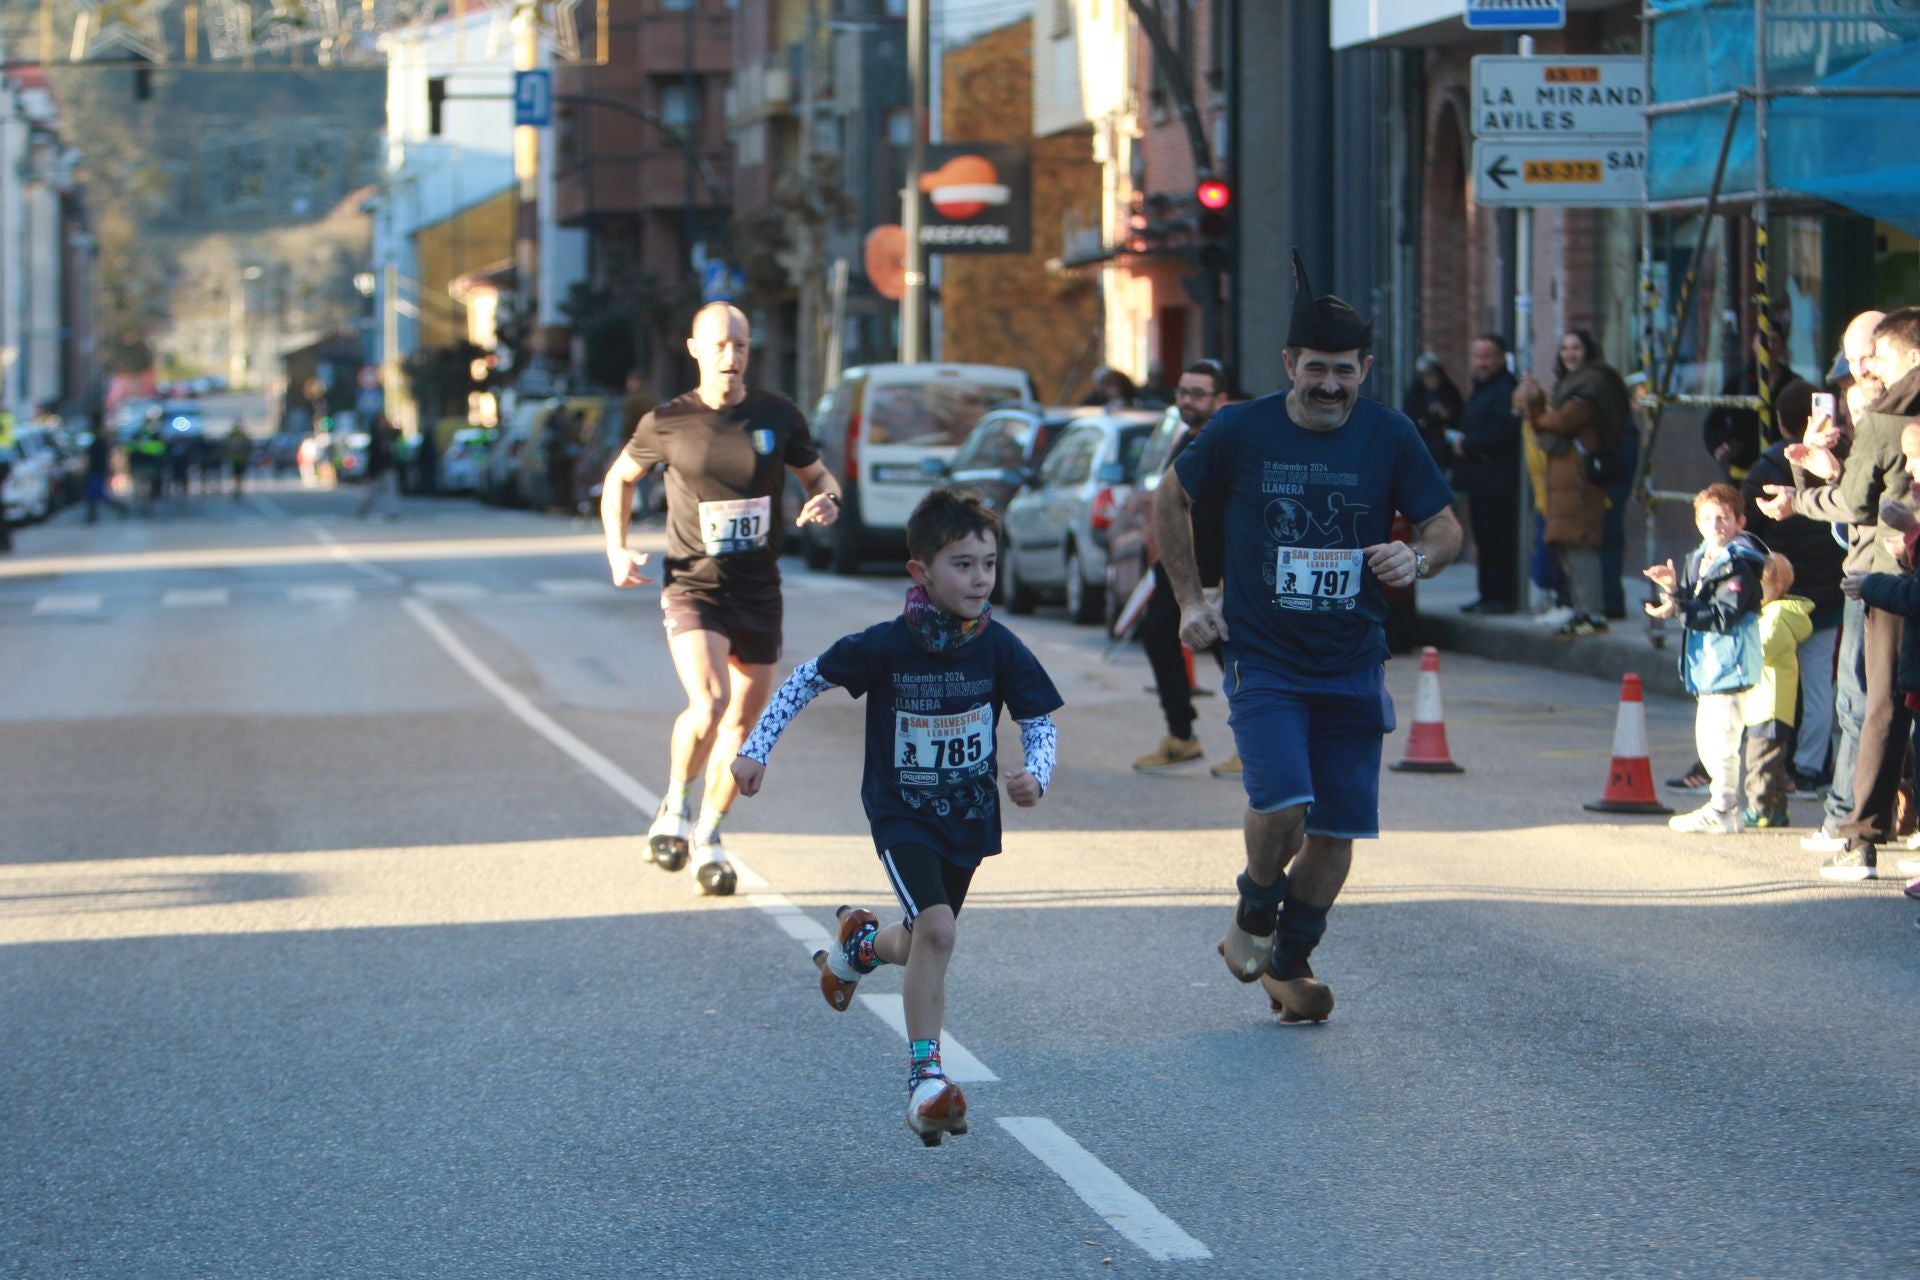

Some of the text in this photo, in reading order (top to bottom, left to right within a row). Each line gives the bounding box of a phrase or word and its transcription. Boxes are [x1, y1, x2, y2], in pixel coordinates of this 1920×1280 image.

[1483, 88, 1514, 105] LA
[1484, 111, 1576, 129] AVILES
[1527, 162, 1599, 180] AS-373
[1263, 461, 1329, 472] 31 diciembre 2024
[1262, 482, 1305, 495] LLANERA
[729, 515, 760, 539] 787
[1291, 549, 1353, 561] SAN SILVESTRE
[1306, 560, 1339, 568] LLANERA
[1311, 570, 1350, 597] 797
[892, 671, 965, 683] 31 diciembre 2024
[920, 683, 944, 698] SAN
[896, 697, 941, 711] LLANERA
[910, 711, 982, 728] SAN SILVESTRE
[927, 727, 967, 737] LLANERA
[930, 733, 982, 768] 785
[903, 773, 936, 781] OQUENDO
